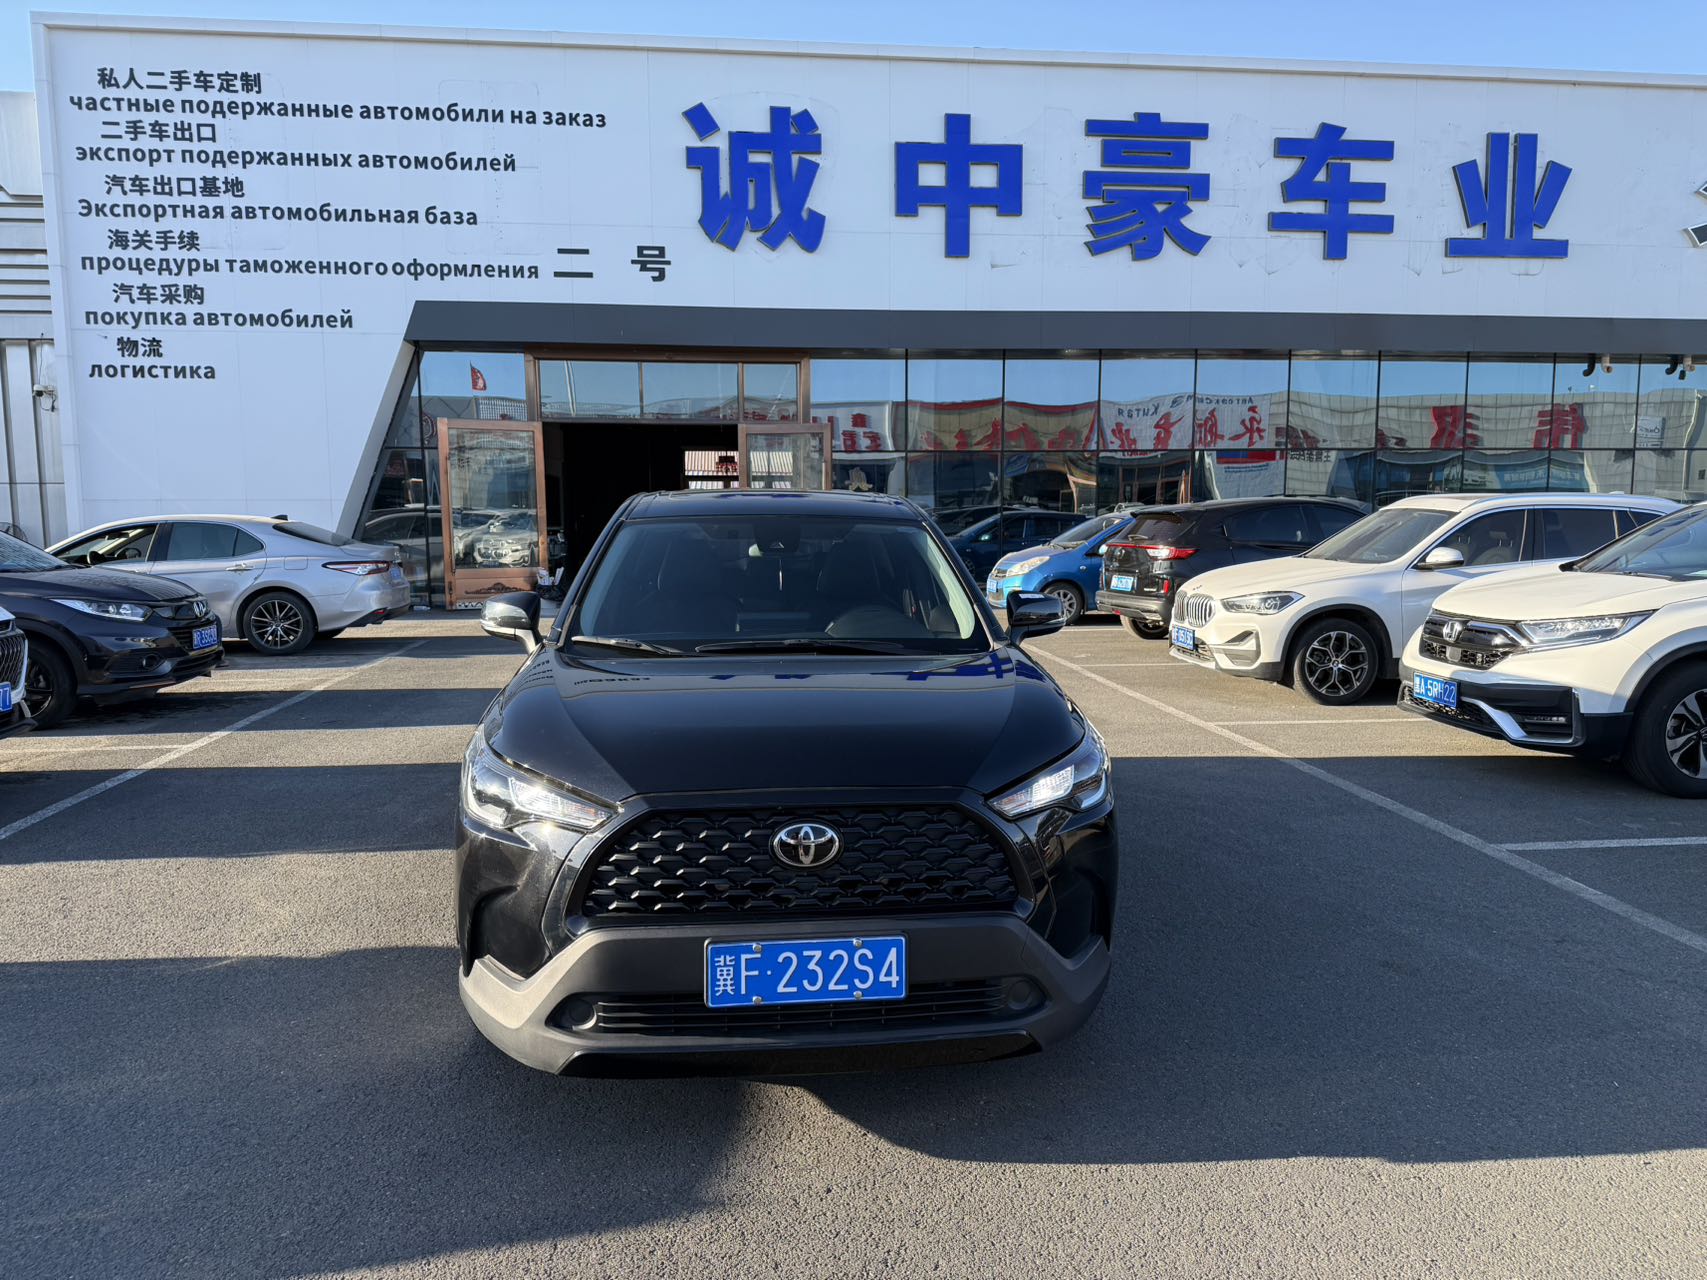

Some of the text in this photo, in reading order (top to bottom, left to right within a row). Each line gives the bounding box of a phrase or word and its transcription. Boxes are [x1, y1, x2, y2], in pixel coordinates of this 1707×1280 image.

[97, 67, 262, 95] 私人二手车定制
[69, 95, 607, 128] частные подержанные автомобили на заказ
[100, 119, 217, 143] 二手车出口
[75, 146, 516, 172] экспорт подержанных автомобилей
[104, 174, 245, 198] 汽车出口基地
[682, 102, 1572, 261] 诚中豪车业
[78, 198, 478, 226] Экспортная автомобильная база
[107, 228, 201, 252] 海关手续
[81, 256, 220, 277] процедуры
[112, 282, 205, 306] 汽车采购
[85, 308, 353, 330] покупка автомобилей
[116, 336, 164, 358] 物流
[88, 364, 216, 380] логистика
